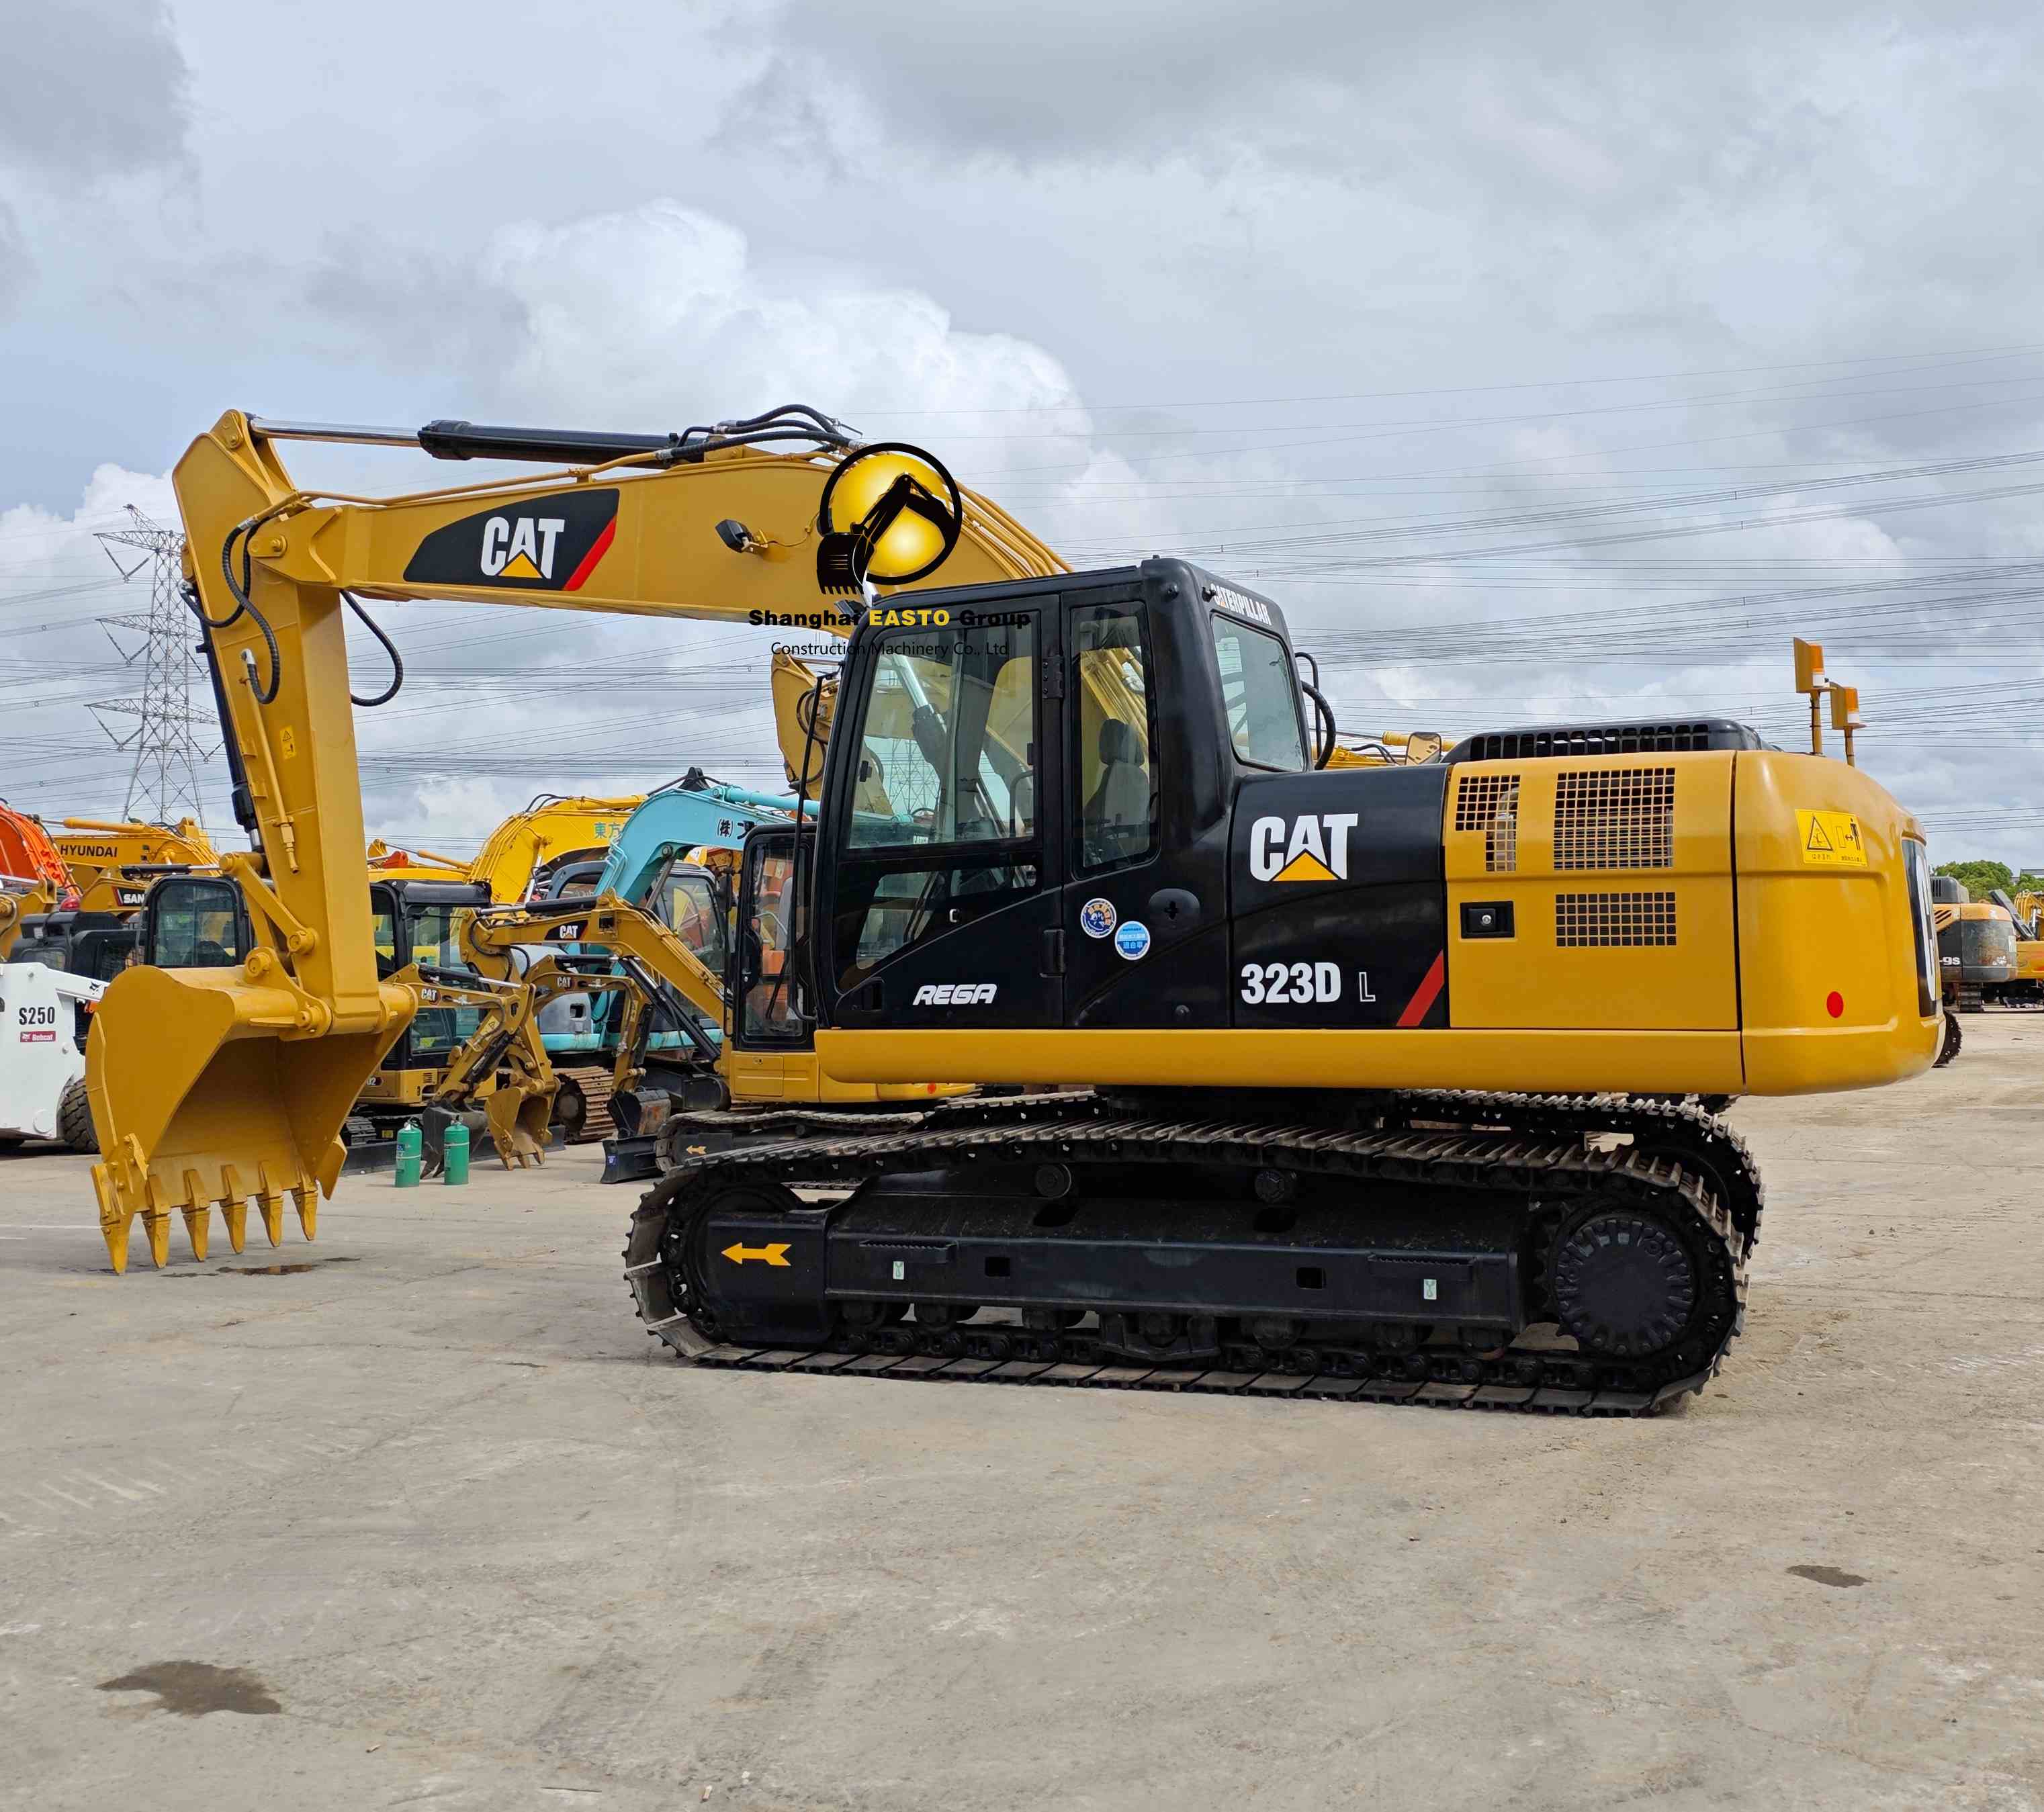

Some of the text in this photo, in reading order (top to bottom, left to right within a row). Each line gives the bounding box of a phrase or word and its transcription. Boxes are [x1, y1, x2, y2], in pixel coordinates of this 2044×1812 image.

[480, 516, 565, 579] CAT
[1210, 583, 1272, 626] CATERPILLAR
[594, 821, 625, 839] 東方
[60, 844, 118, 858] HYUNDAI
[1249, 813, 1358, 882] CAT
[123, 893, 145, 904] SAN
[560, 925, 578, 939] CAT
[557, 977, 571, 988] CAT
[1241, 962, 1376, 1004] 323D L
[421, 988, 437, 1001] CAT
[912, 983, 997, 1005] REGA
[19, 1007, 56, 1026] S250
[32, 1033, 54, 1042] Bobcat
